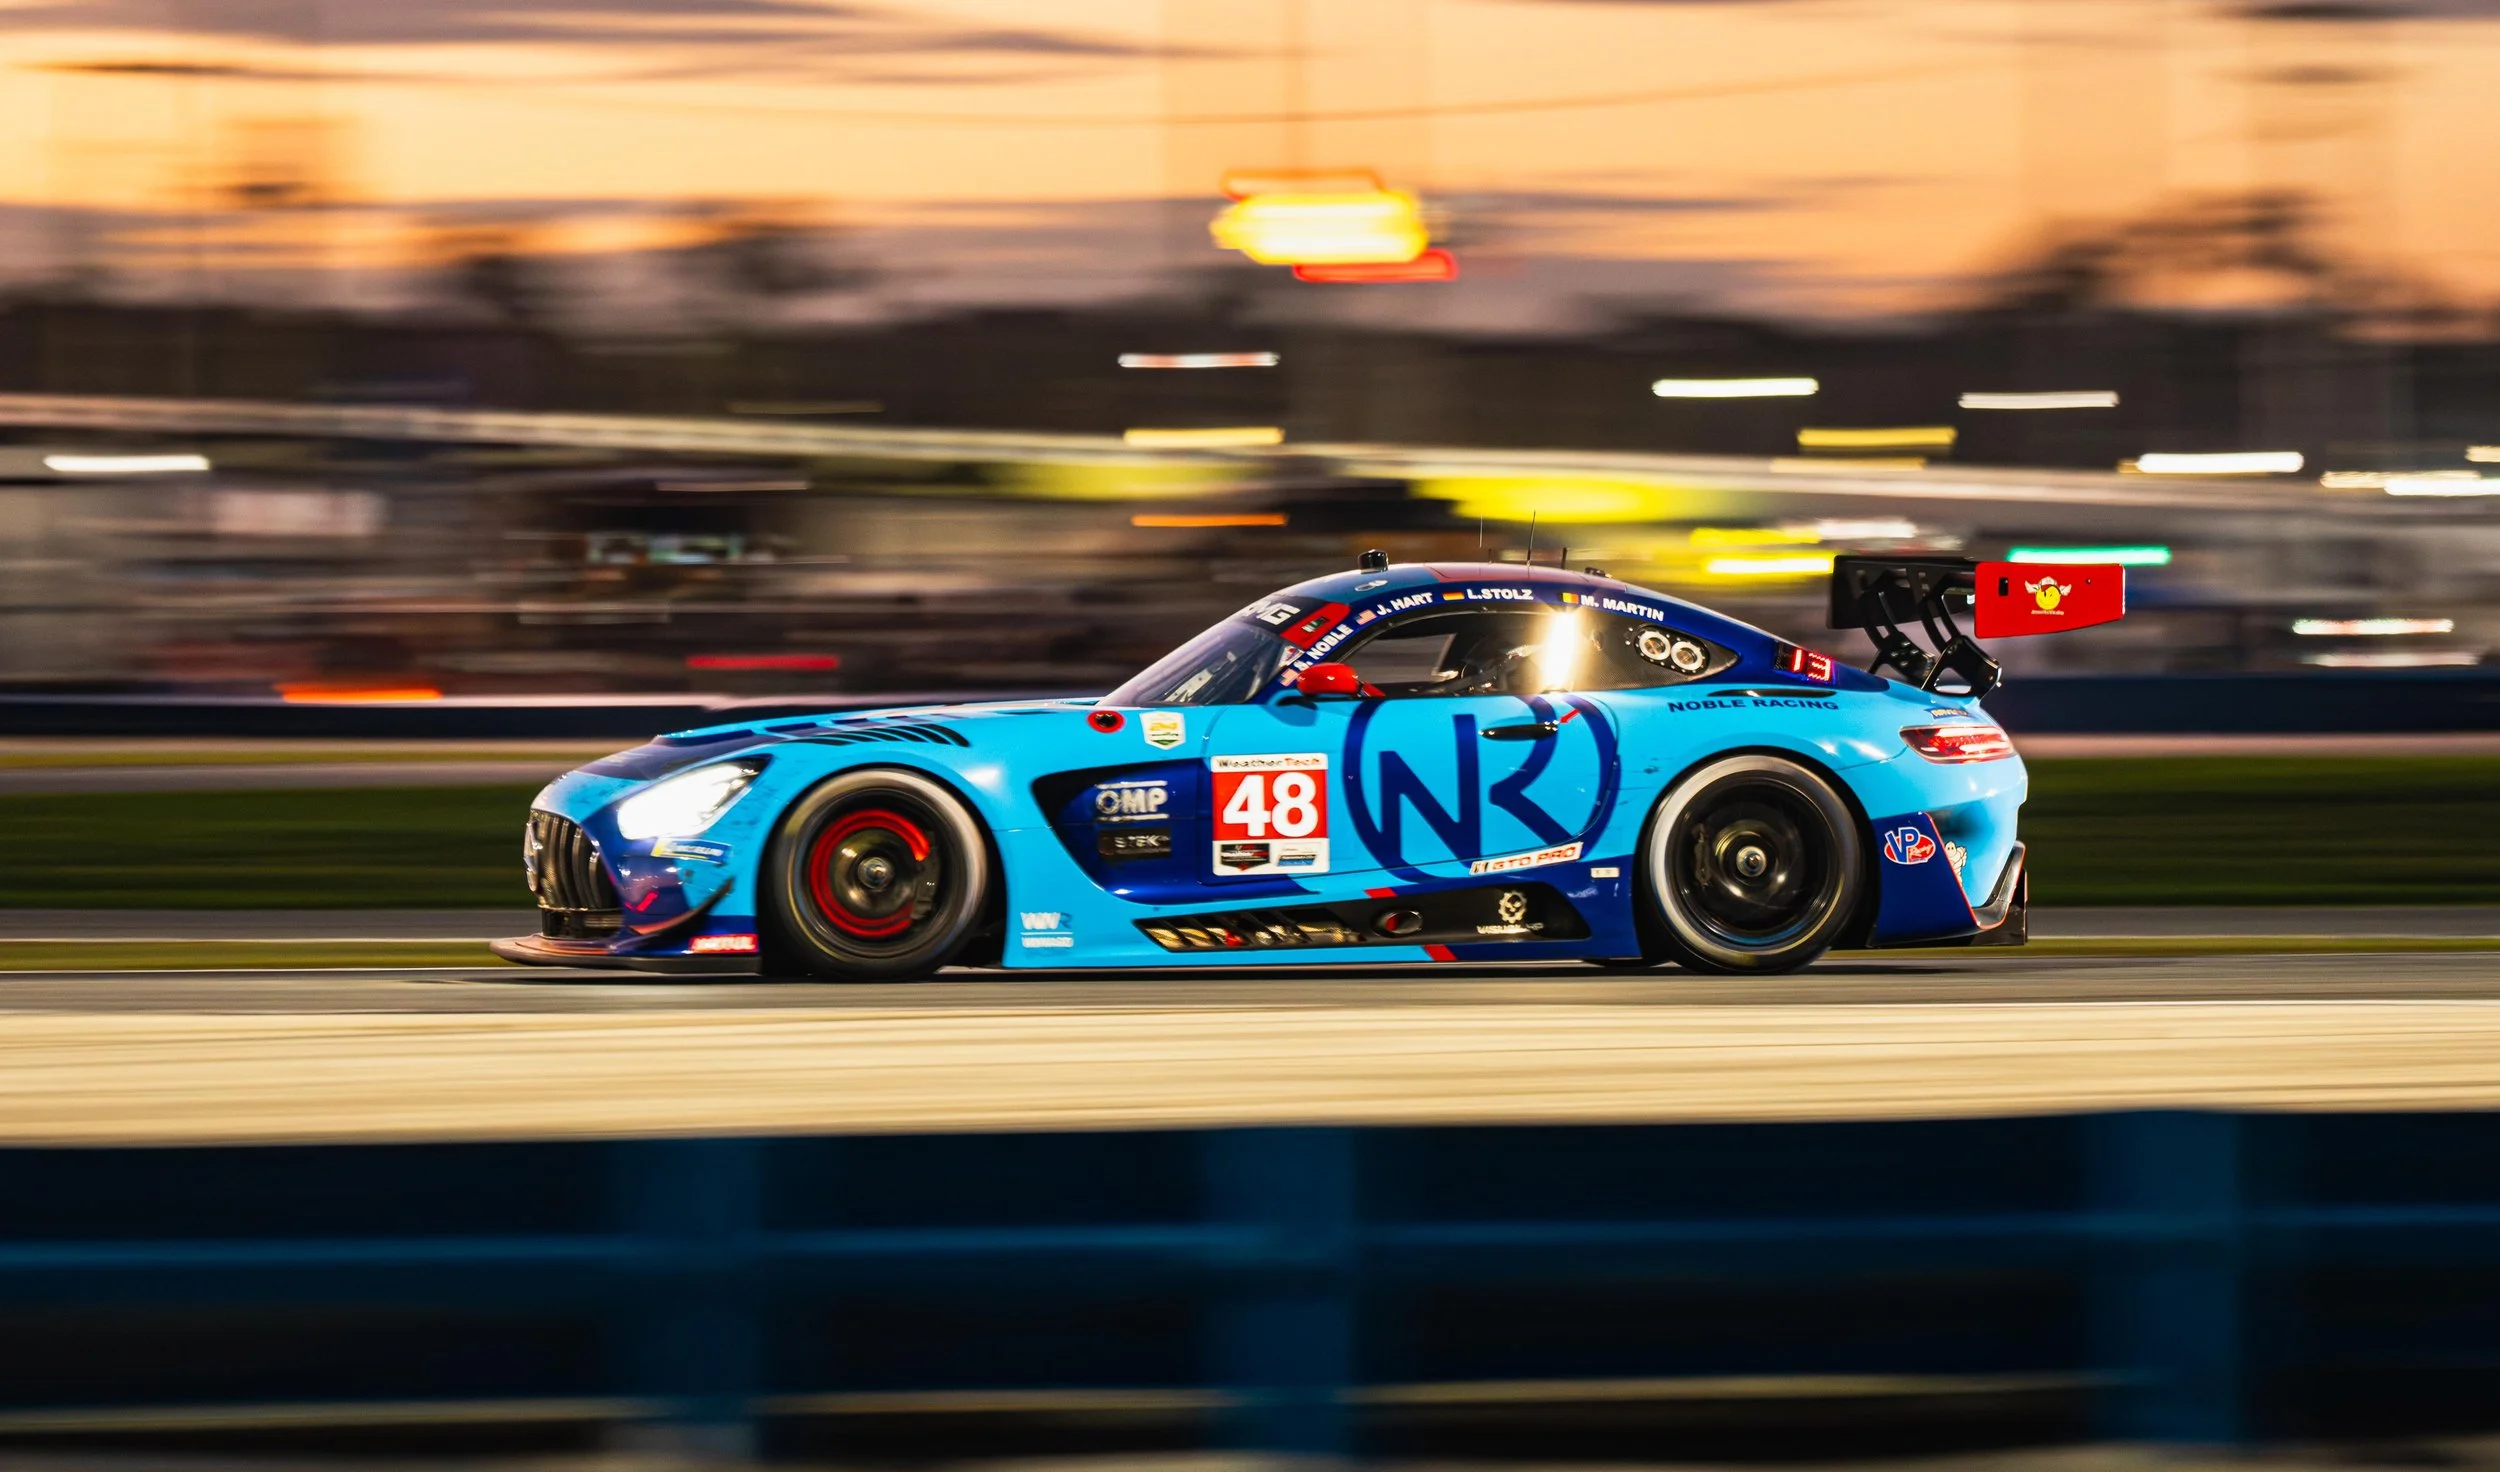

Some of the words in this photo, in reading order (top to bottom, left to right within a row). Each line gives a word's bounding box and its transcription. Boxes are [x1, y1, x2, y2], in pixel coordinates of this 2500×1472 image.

[1376, 604, 1392, 616] J.
[1394, 592, 1433, 610] HART
[1466, 588, 1534, 600] L.STOLZ
[1580, 594, 1599, 607] M.
[1603, 597, 1664, 621] MARTIN
[1306, 623, 1354, 660] NOBLE
[1668, 699, 1746, 713] NOBLE
[1752, 698, 1839, 711] RACING
[1096, 787, 1168, 815] OMP
[1223, 774, 1319, 838] 48
[1535, 846, 1577, 864] PRO
[1885, 827, 1920, 865] VP
